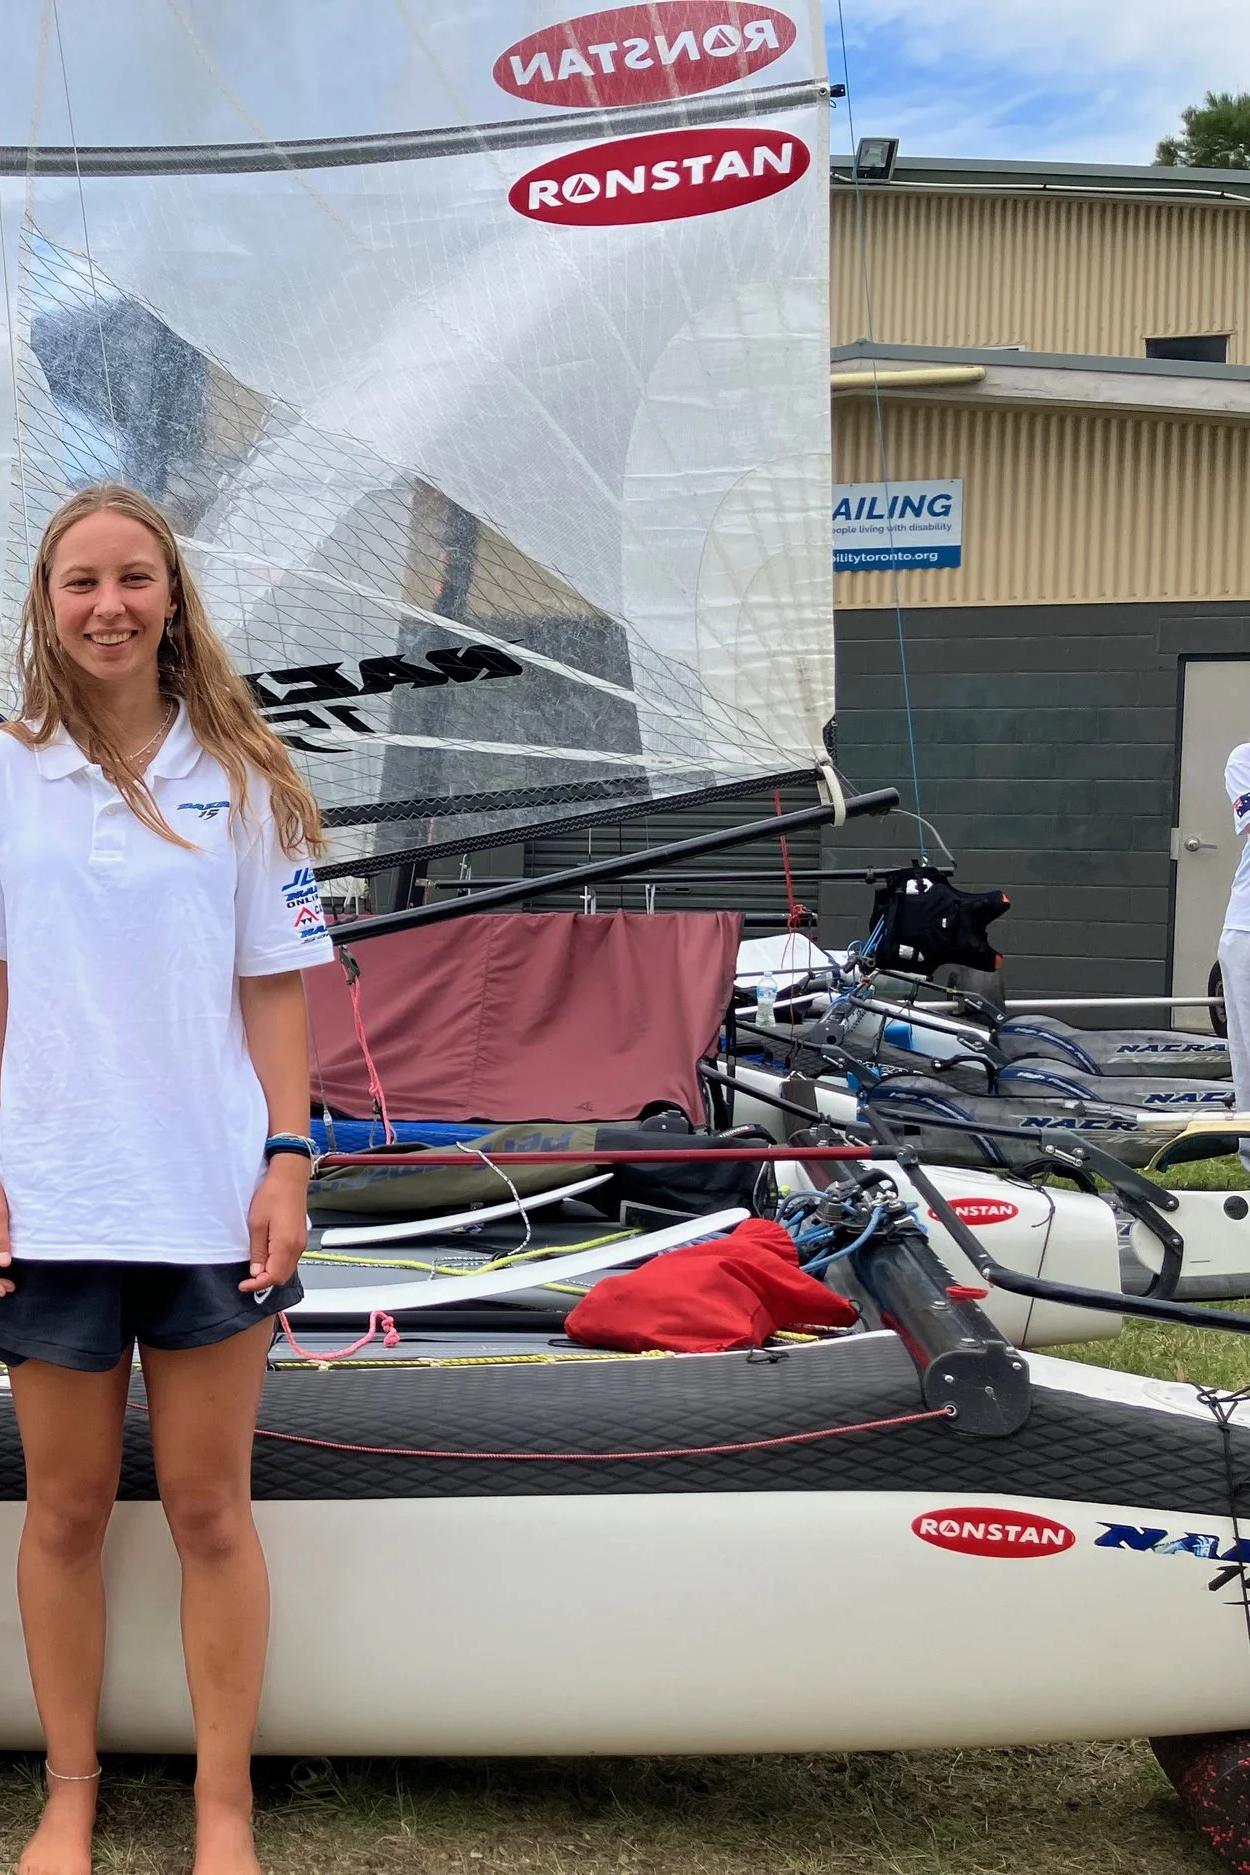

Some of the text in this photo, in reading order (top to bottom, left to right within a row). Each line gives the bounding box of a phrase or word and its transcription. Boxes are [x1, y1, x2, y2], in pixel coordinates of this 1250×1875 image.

[527, 142, 794, 211] RONSTAN
[832, 493, 953, 521] AILING
[859, 524, 885, 535] living
[886, 522, 907, 533] with
[909, 521, 953, 533] disability
[1116, 1043, 1227, 1054] NACRA
[932, 1204, 1014, 1217] NSTAN
[919, 1517, 1066, 1546] RONSTAN
